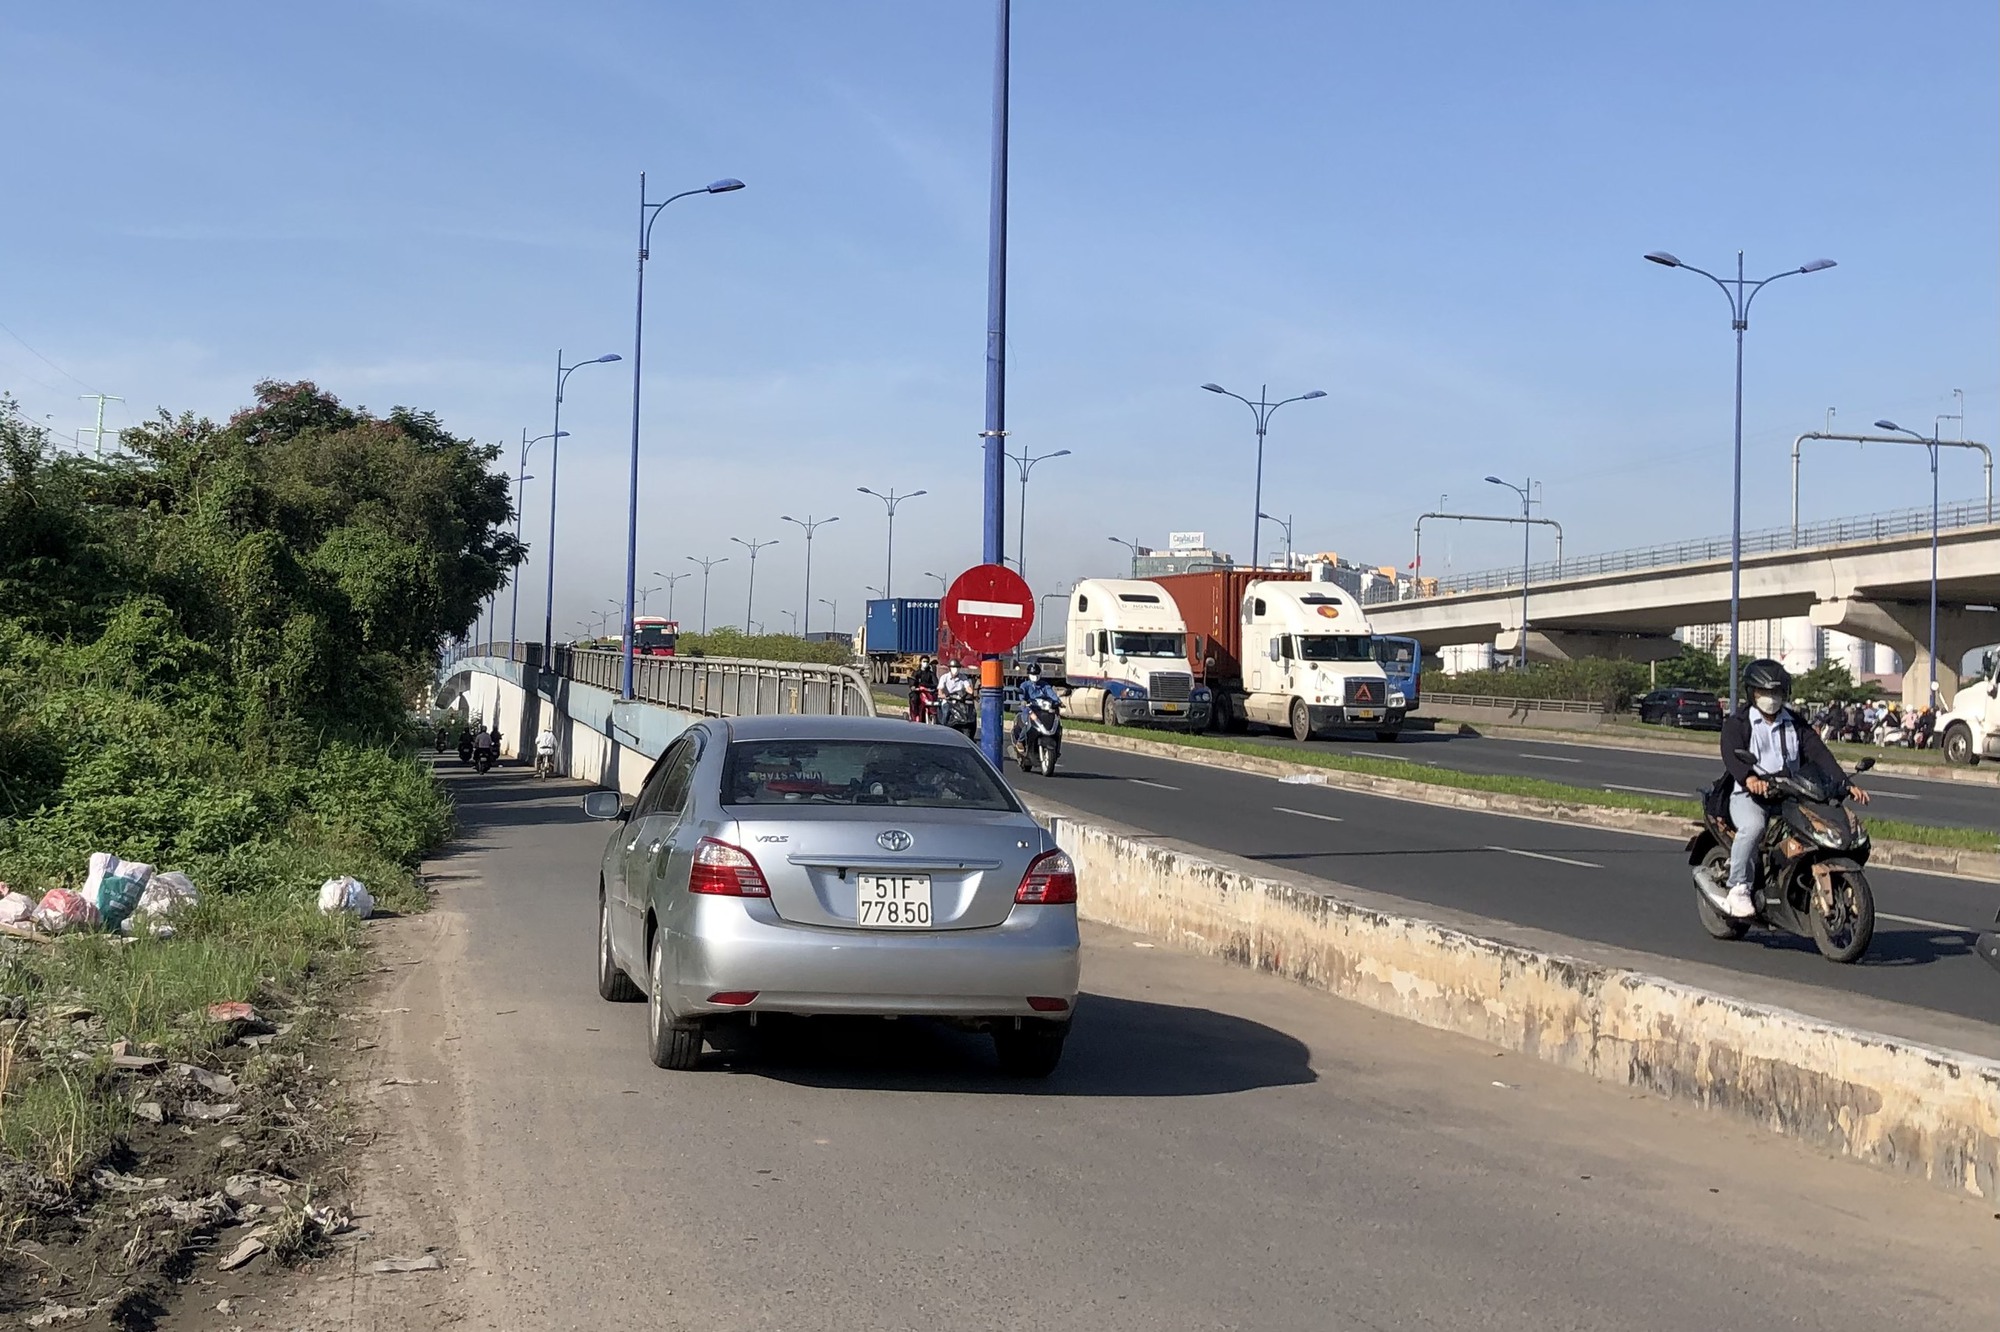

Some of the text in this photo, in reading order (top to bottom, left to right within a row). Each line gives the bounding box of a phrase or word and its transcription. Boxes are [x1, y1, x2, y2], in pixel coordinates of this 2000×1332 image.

[755, 835, 790, 843] VIOS
[876, 877, 913, 900] 51F
[861, 901, 929, 924] 778.50
